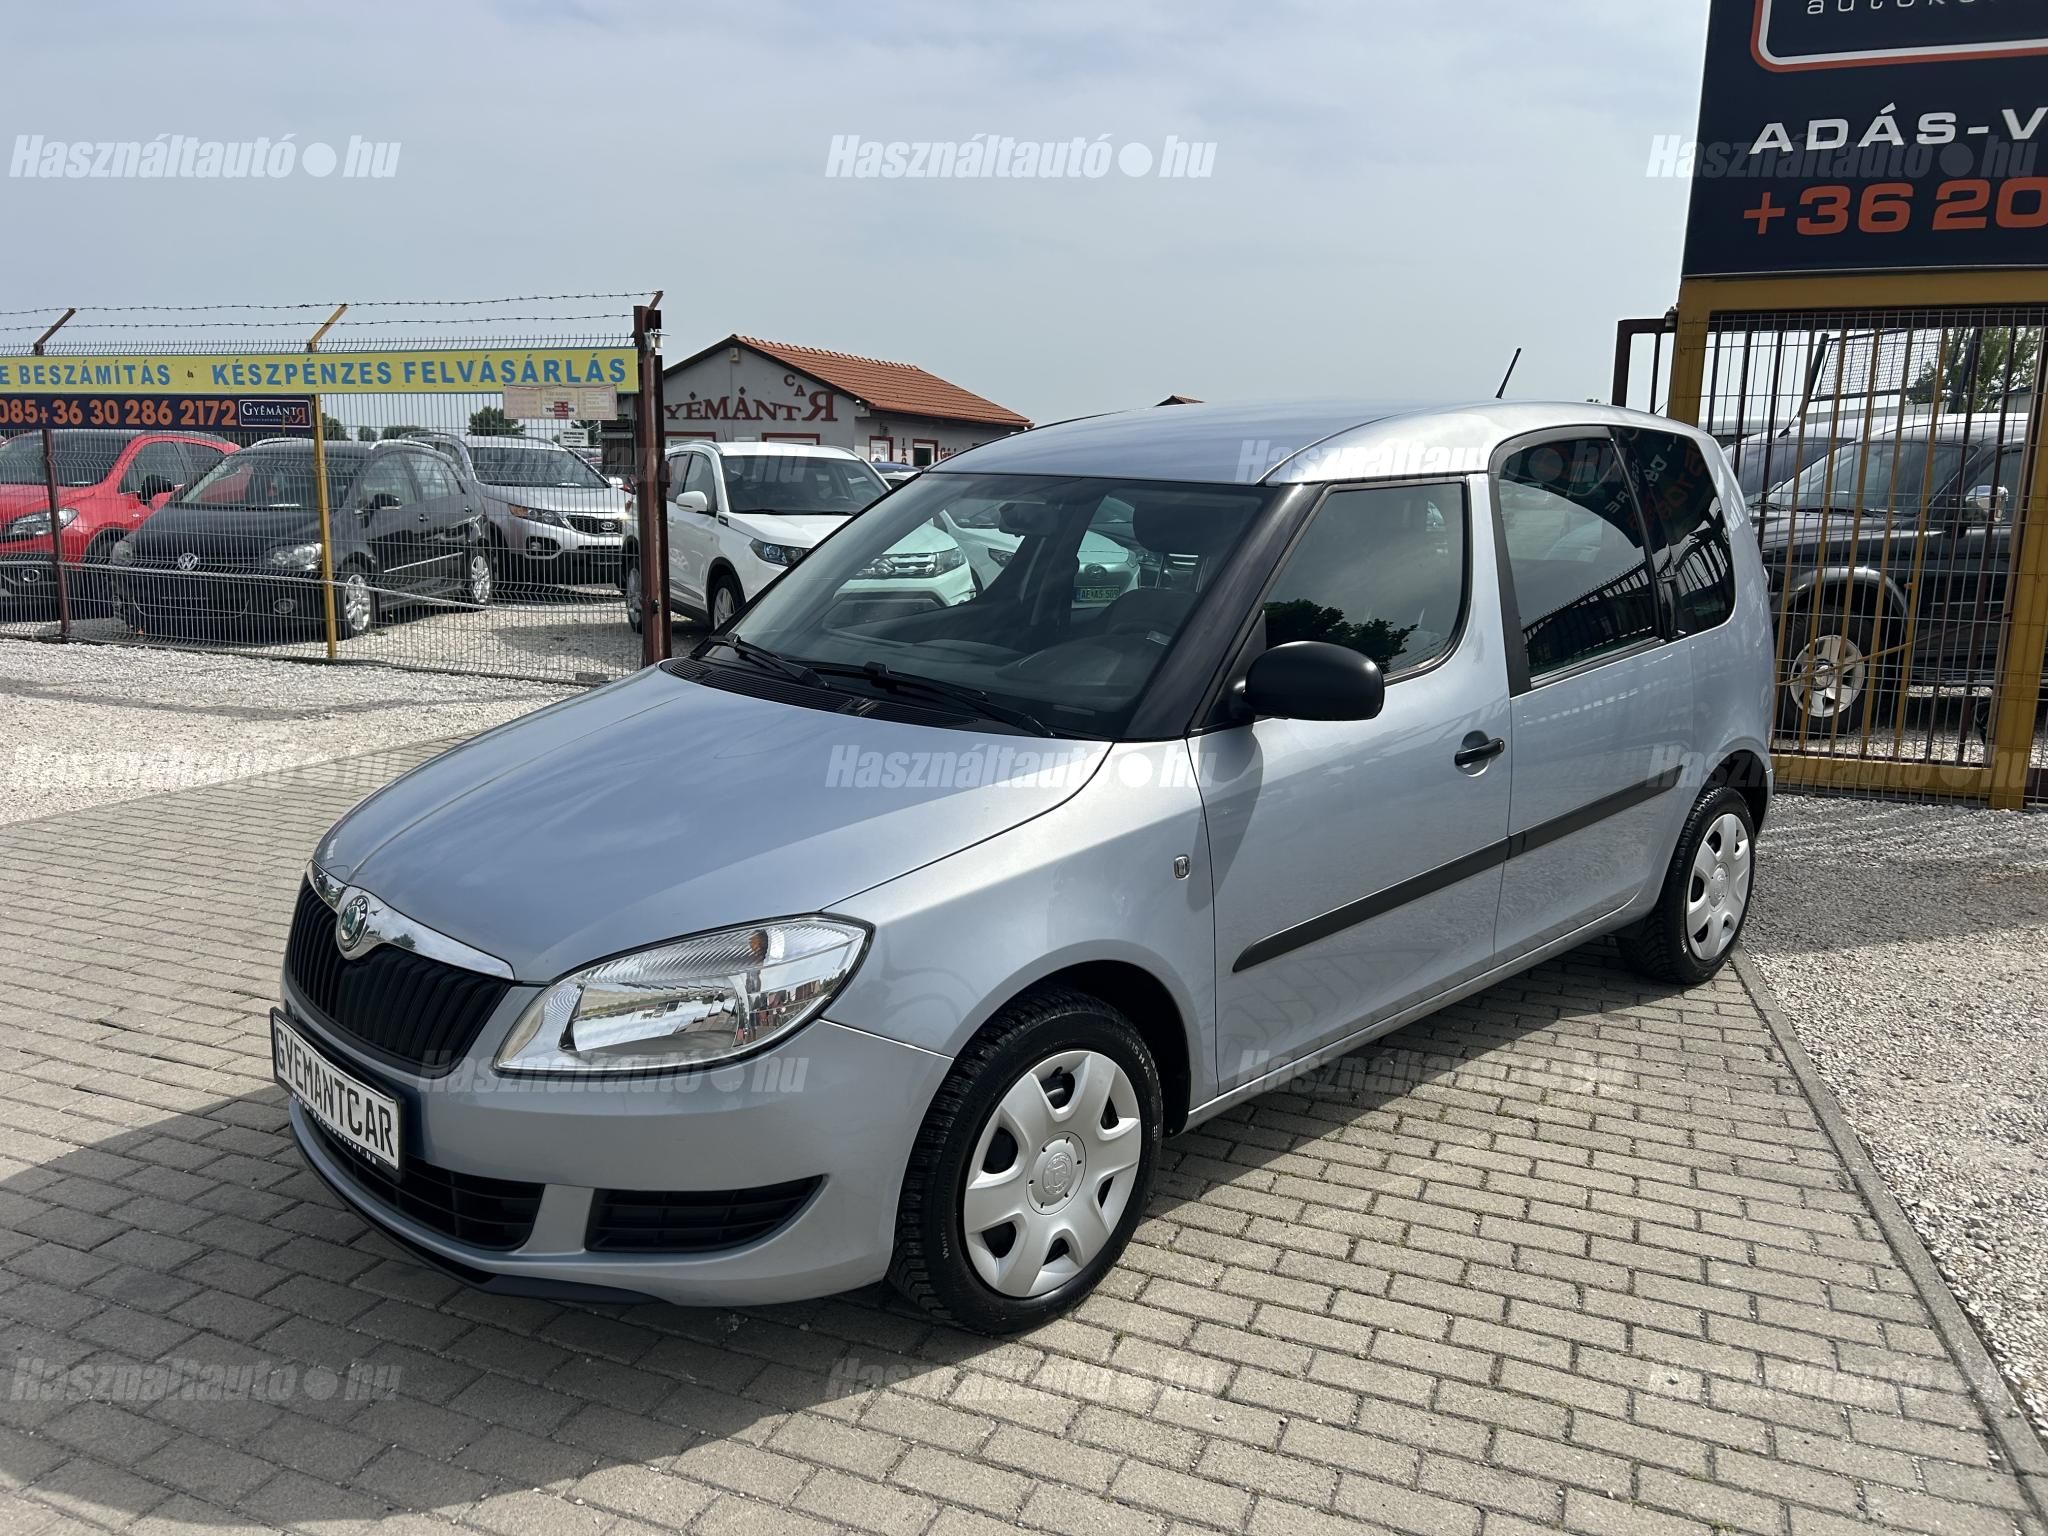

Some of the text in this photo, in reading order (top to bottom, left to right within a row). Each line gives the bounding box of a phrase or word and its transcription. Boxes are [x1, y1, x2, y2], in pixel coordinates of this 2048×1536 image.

[1931, 176, 2048, 231] 20
[18, 359, 171, 385] BESZÁMÍTÁS
[212, 358, 392, 385] KÉSZPÉNZES
[404, 353, 626, 384] FELVÁSÁRLÁS
[90, 399, 120, 425] 30
[124, 399, 173, 426] 286
[180, 399, 237, 427] 2172
[664, 386, 802, 421] YÉMÁNT
[275, 1026, 395, 1159] GYEMANTCAR
